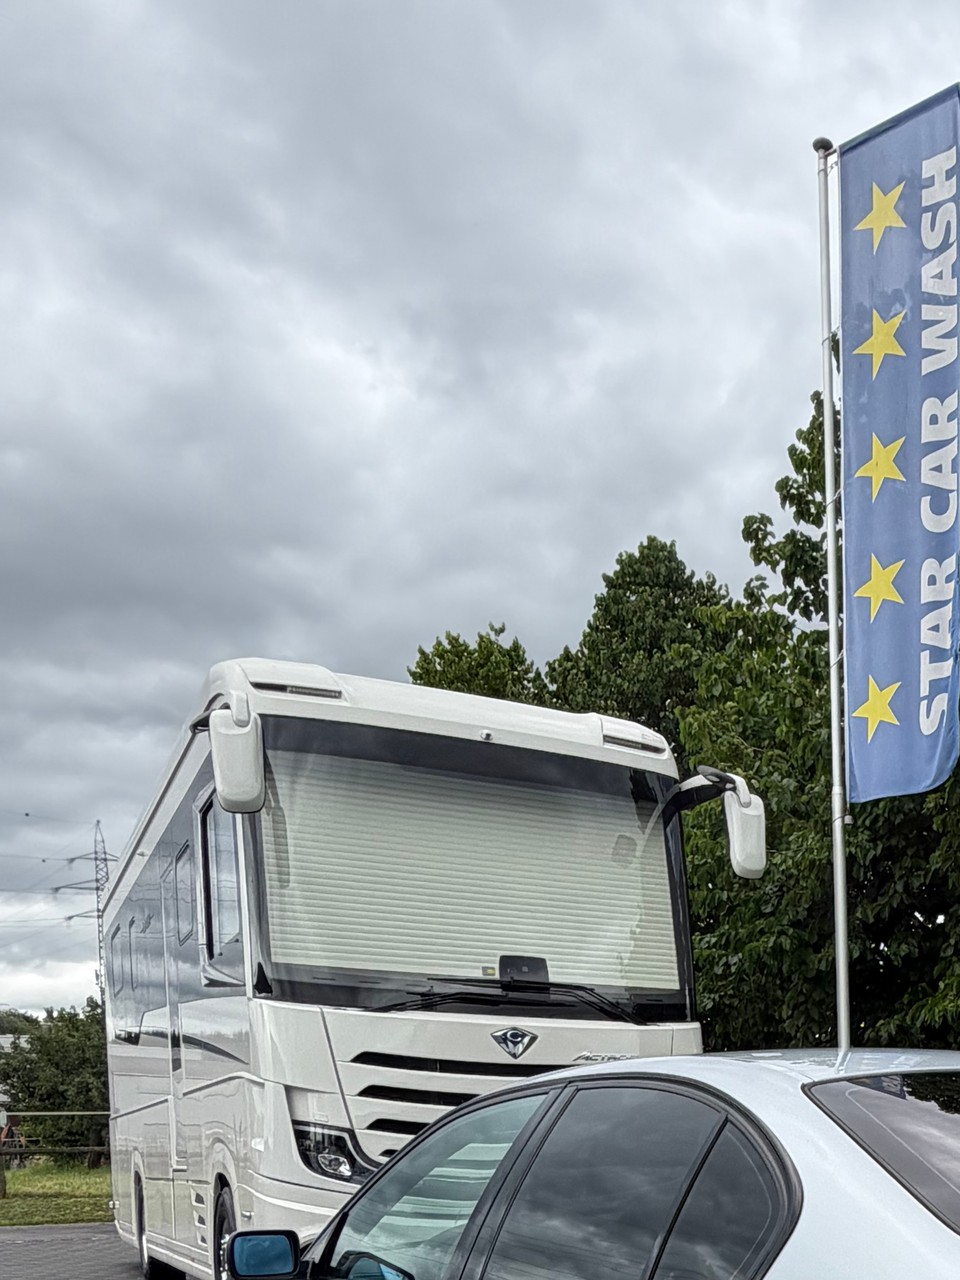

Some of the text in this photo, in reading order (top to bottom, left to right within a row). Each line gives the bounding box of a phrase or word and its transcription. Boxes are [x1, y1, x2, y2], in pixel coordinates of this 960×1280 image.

[919, 145, 958, 736] STAR CAR WASH
